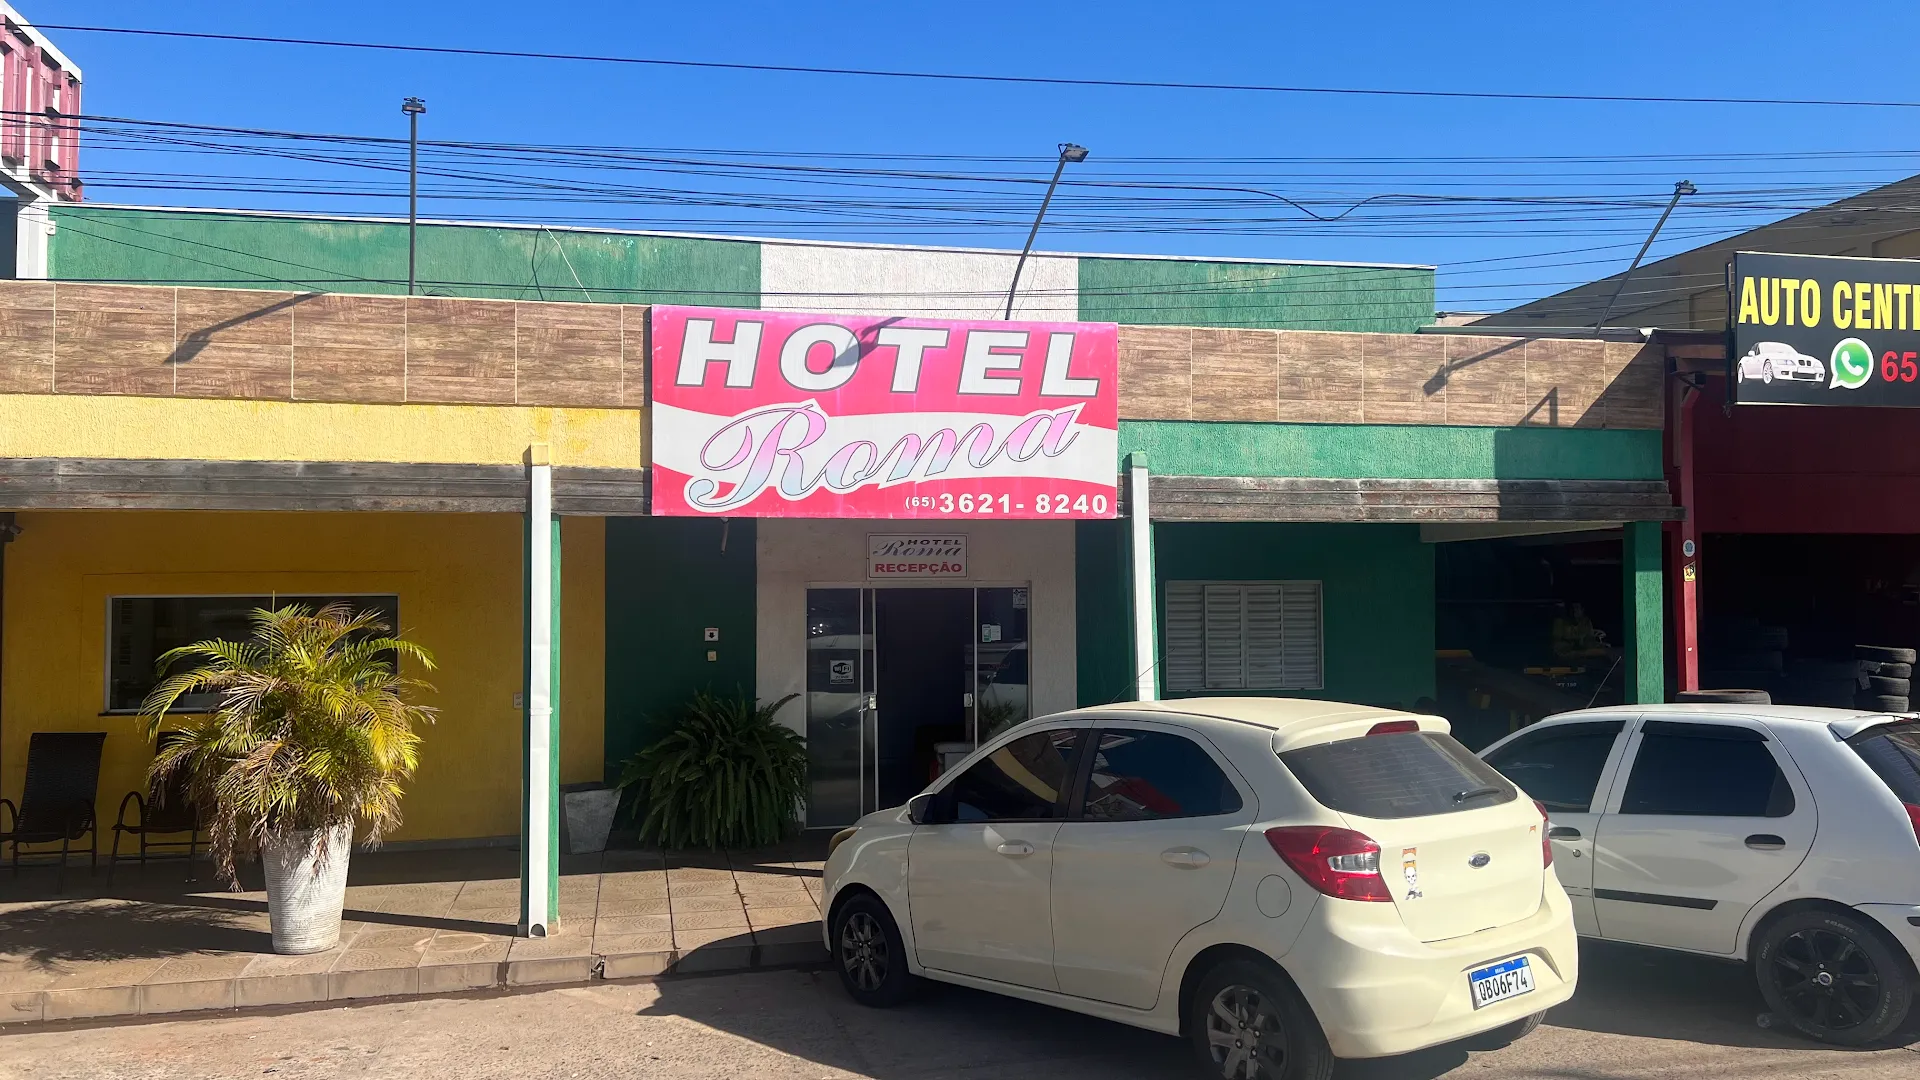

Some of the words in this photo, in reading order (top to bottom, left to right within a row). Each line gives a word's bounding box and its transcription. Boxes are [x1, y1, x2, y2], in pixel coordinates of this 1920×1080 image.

[1738, 276, 1821, 328] AUTO
[674, 317, 1100, 397] HOTEL
[1881, 351, 1918, 383] 65
[688, 403, 1080, 508] Roma
[905, 495, 936, 509] (65)
[1035, 494, 1108, 514] 8240
[873, 540, 961, 557] Roma
[875, 561, 963, 575] RECEPÇÃO
